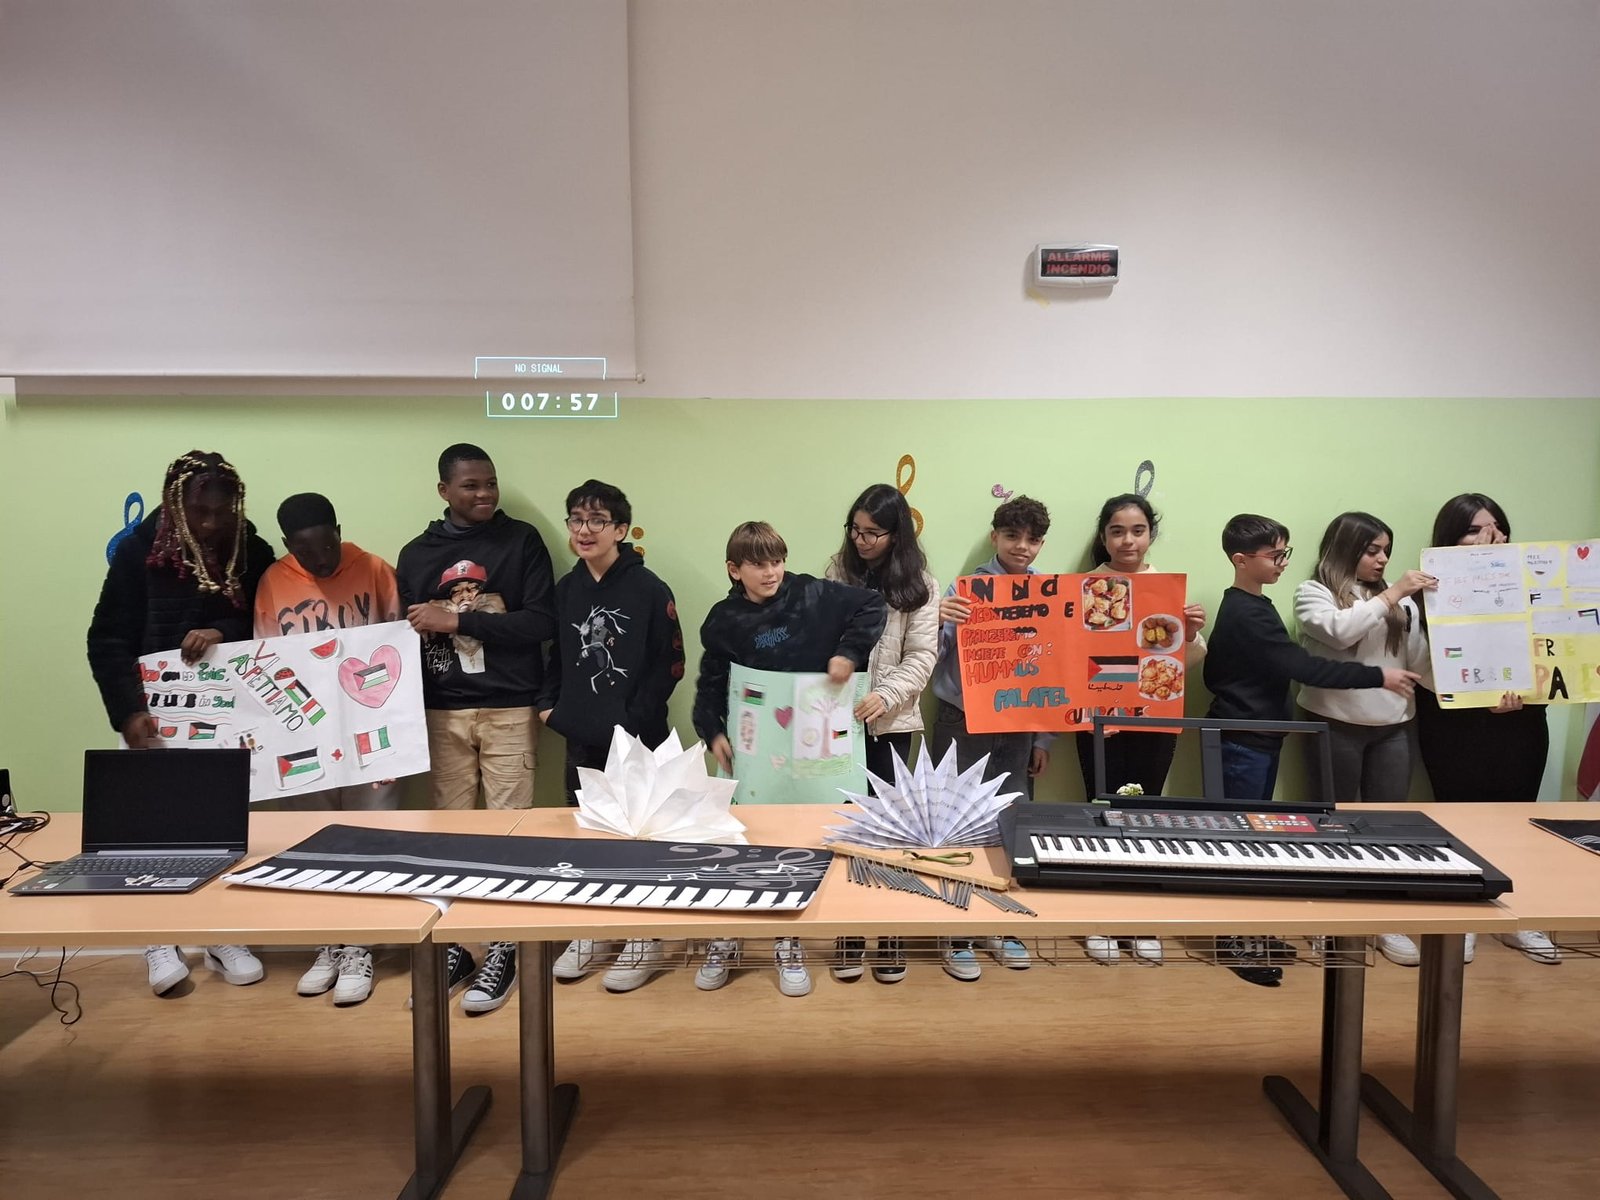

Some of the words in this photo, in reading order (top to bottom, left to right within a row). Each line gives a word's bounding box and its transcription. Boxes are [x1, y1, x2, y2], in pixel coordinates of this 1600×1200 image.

[1048, 252, 1110, 262] ALLARME
[1046, 264, 1111, 274] INCENDIO
[514, 364, 527, 373] NO
[530, 364, 563, 373] SIGNAL
[1064, 602, 1075, 618] E
[965, 657, 1040, 688] HUMMUS
[228, 654, 304, 732] ASPETTIAMO
[993, 686, 1070, 713] FALAFEL
